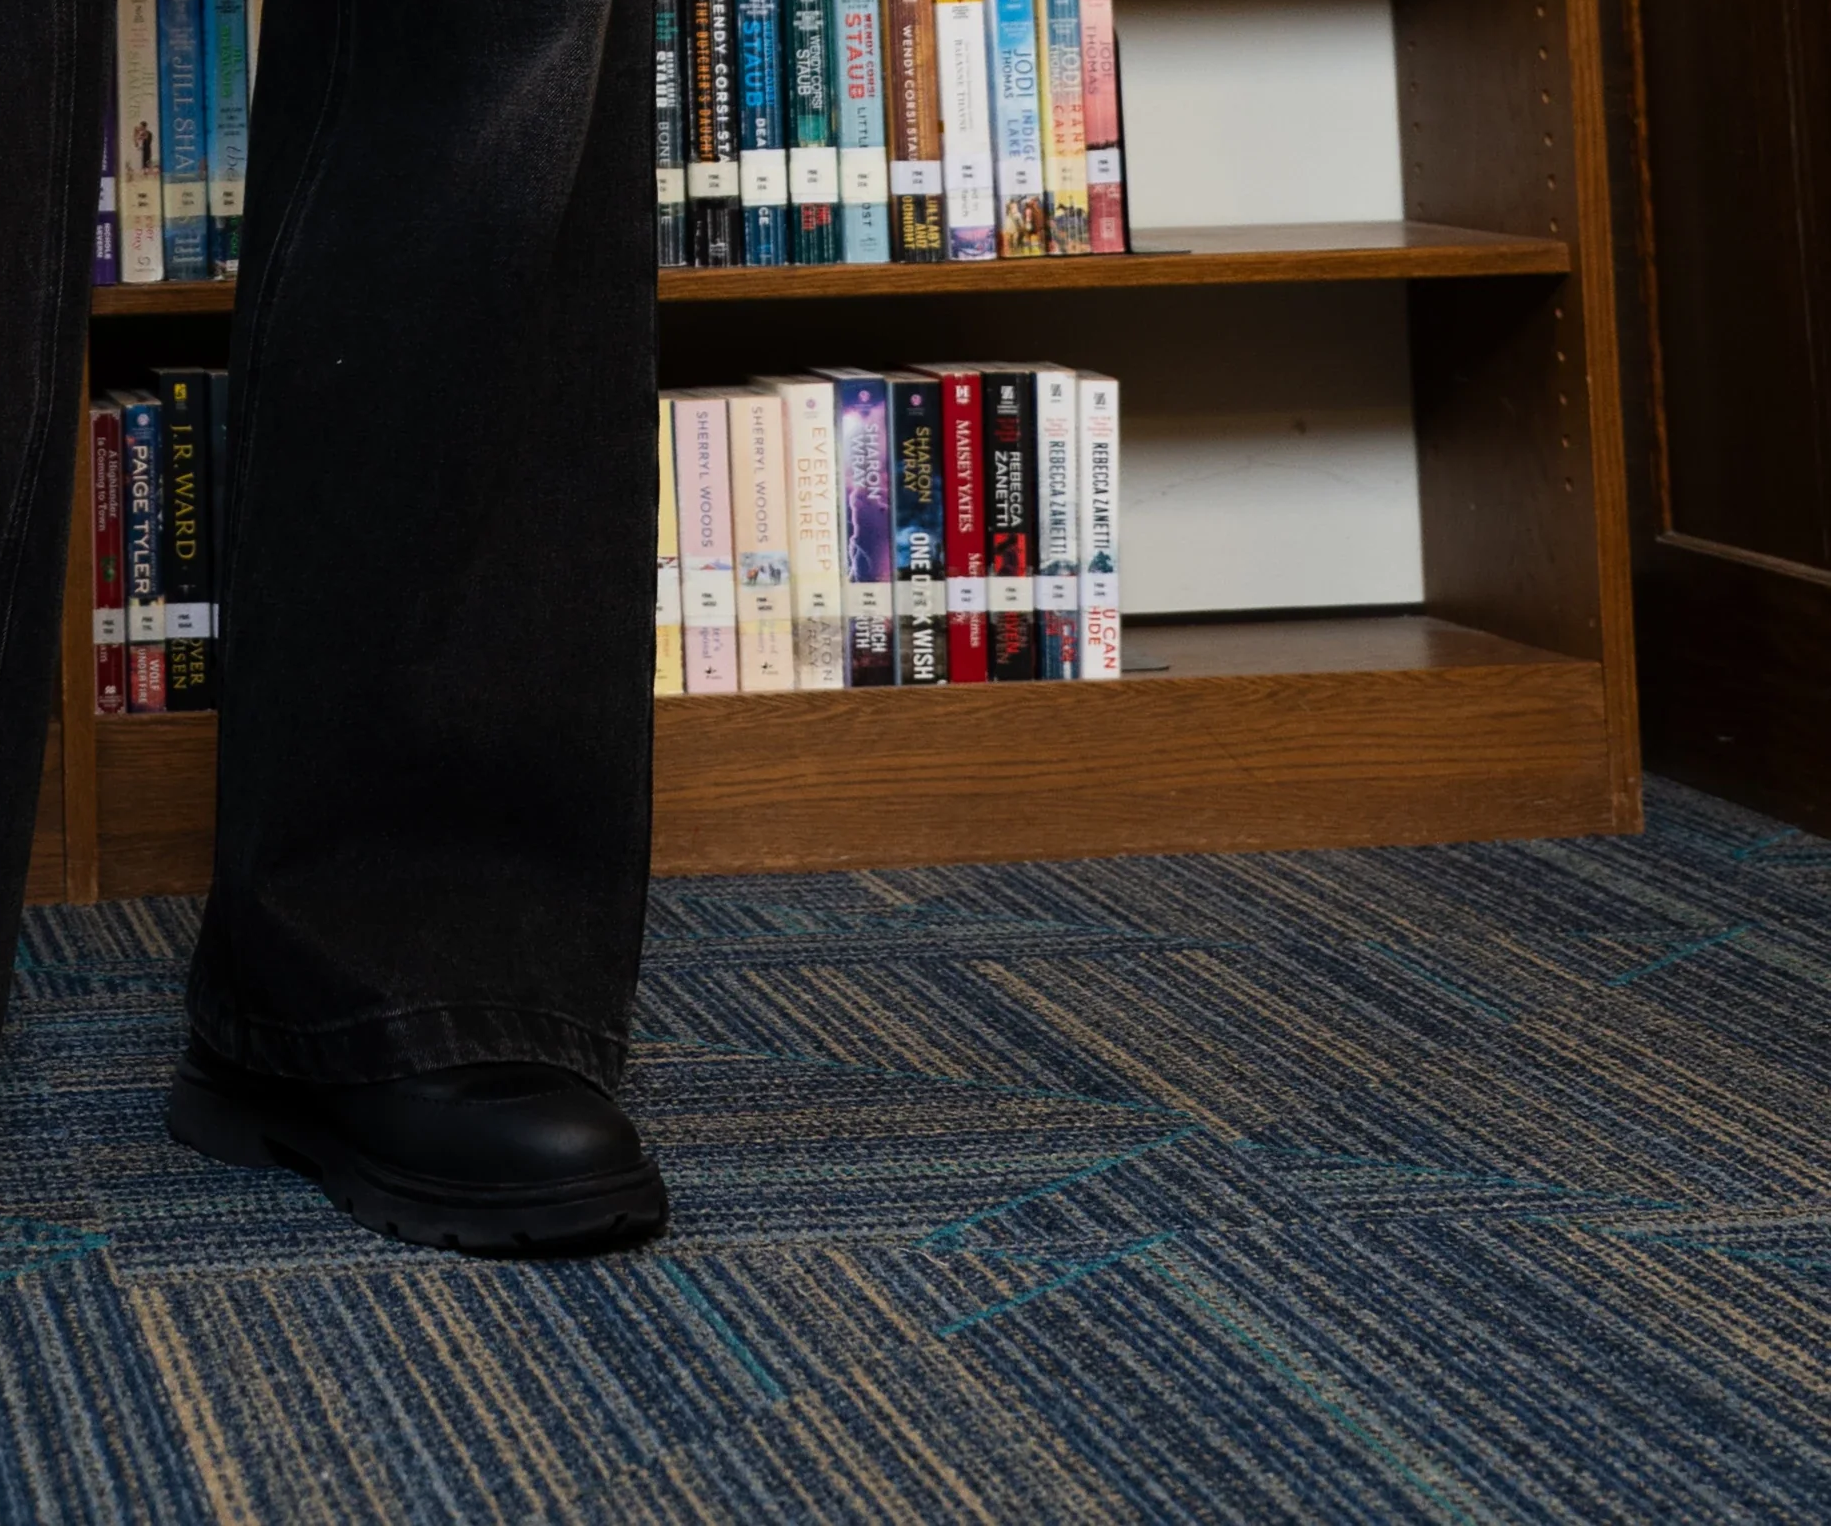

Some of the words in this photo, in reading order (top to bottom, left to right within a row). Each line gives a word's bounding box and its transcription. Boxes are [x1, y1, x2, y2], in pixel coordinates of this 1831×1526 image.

[845, 13, 865, 98] STAUB
[1003, 49, 1013, 98] THOMAS
[1013, 52, 1034, 98] JODI
[715, 64, 729, 122] CORSI
[170, 424, 193, 467] J.R.
[697, 412, 710, 480] SHERRYL
[812, 427, 827, 499] EVERY
[956, 420, 971, 481] MAISEY
[1092, 443, 1110, 496] REBECCA
[132, 445, 149, 514] PAIGE
[797, 457, 812, 541] DESIRE
[958, 484, 972, 533] YATES
[174, 471, 196, 560] WARD
[699, 487, 714, 548] WOODS
[816, 512, 831, 570] DEEP
[1093, 500, 1113, 550] ZANETTI
[133, 520, 150, 593] TYLER
[910, 533, 933, 570] ONE
[913, 631, 934, 679] WISH
